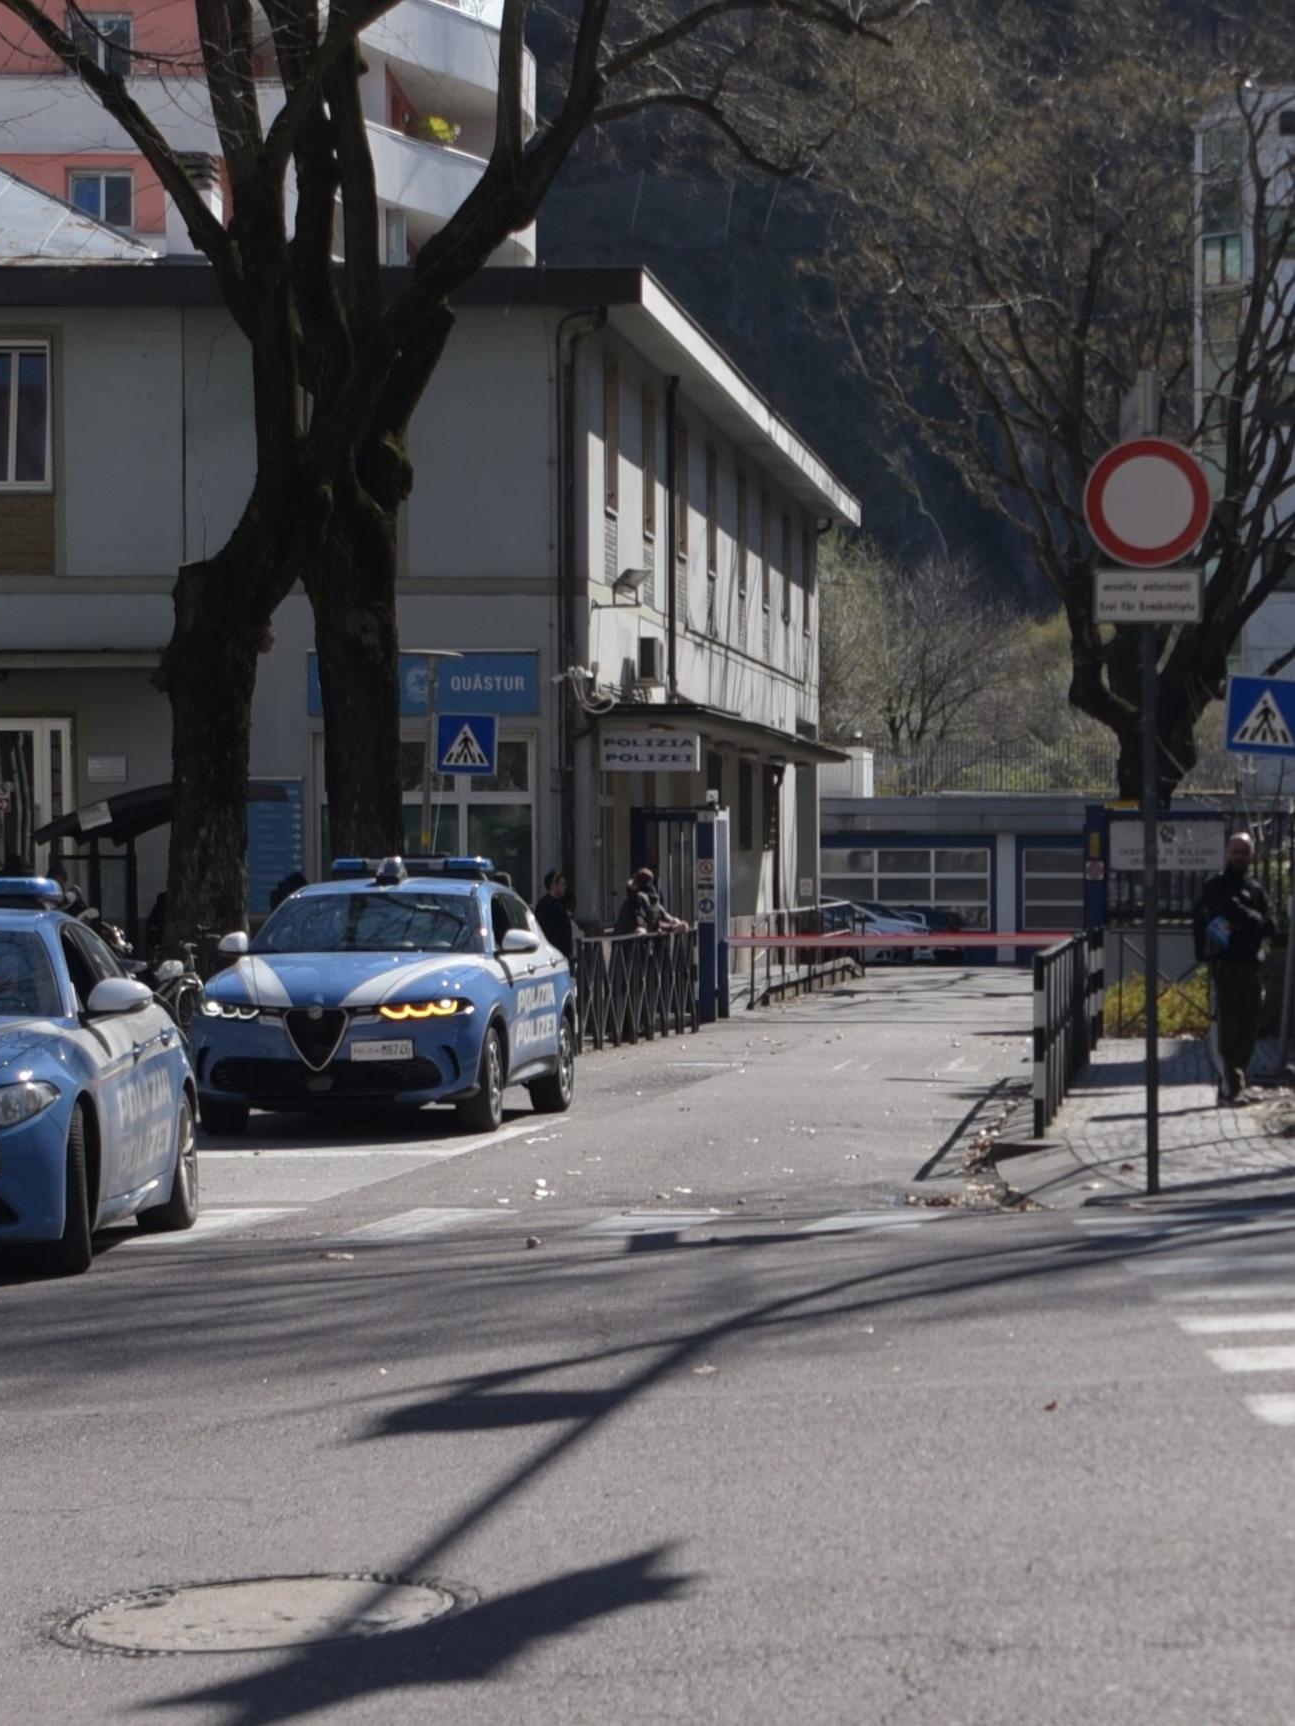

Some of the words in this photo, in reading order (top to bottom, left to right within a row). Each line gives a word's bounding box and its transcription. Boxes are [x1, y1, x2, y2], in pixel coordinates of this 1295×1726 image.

[451, 673, 525, 692] QUÄSTUR
[604, 738, 694, 748] POLIZIA
[605, 754, 692, 763] POLIZEI
[517, 981, 556, 1016] POLIZIA
[516, 1012, 557, 1048] POLIZEI
[117, 1066, 172, 1128] POLIZIA
